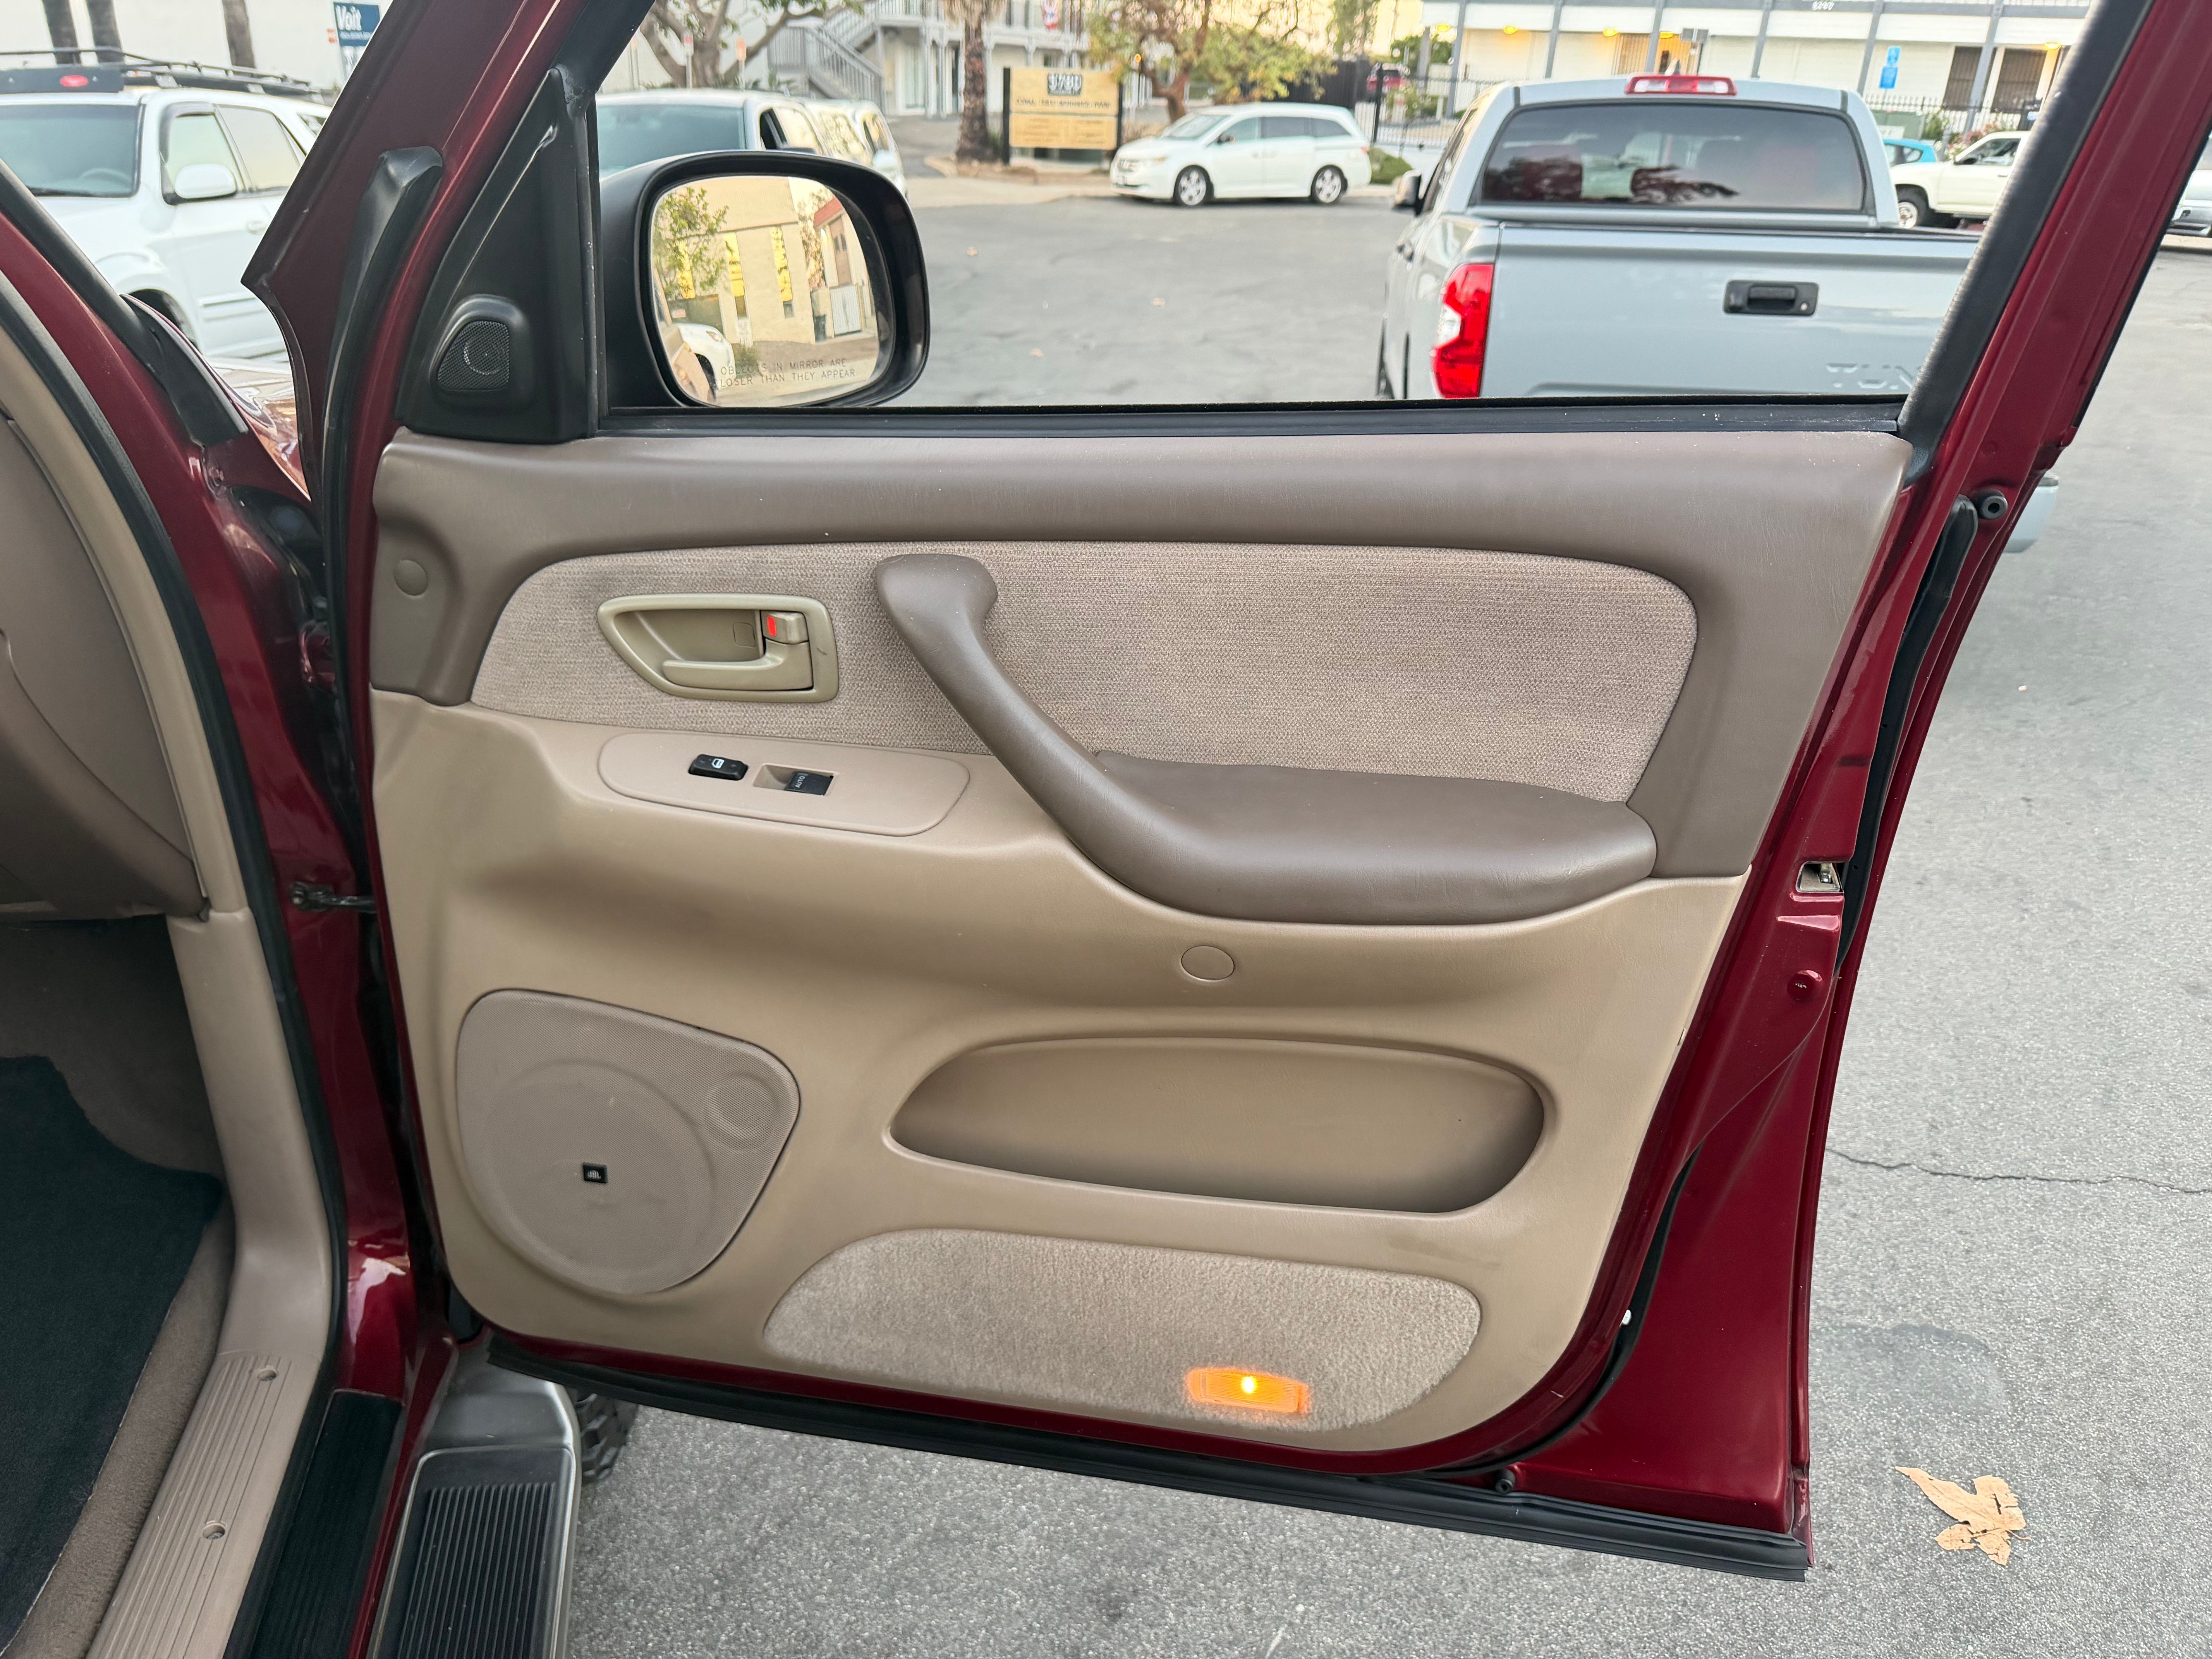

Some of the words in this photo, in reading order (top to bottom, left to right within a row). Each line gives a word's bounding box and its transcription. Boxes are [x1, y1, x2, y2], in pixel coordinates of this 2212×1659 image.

[775, 362, 783, 371] IN
[790, 359, 823, 369] MIRROR
[831, 359, 847, 368] ARE
[761, 374, 785, 383] THAN
[793, 371, 815, 381] THEY
[822, 369, 855, 379] APPEAR
[795, 776, 805, 788] AUTO
